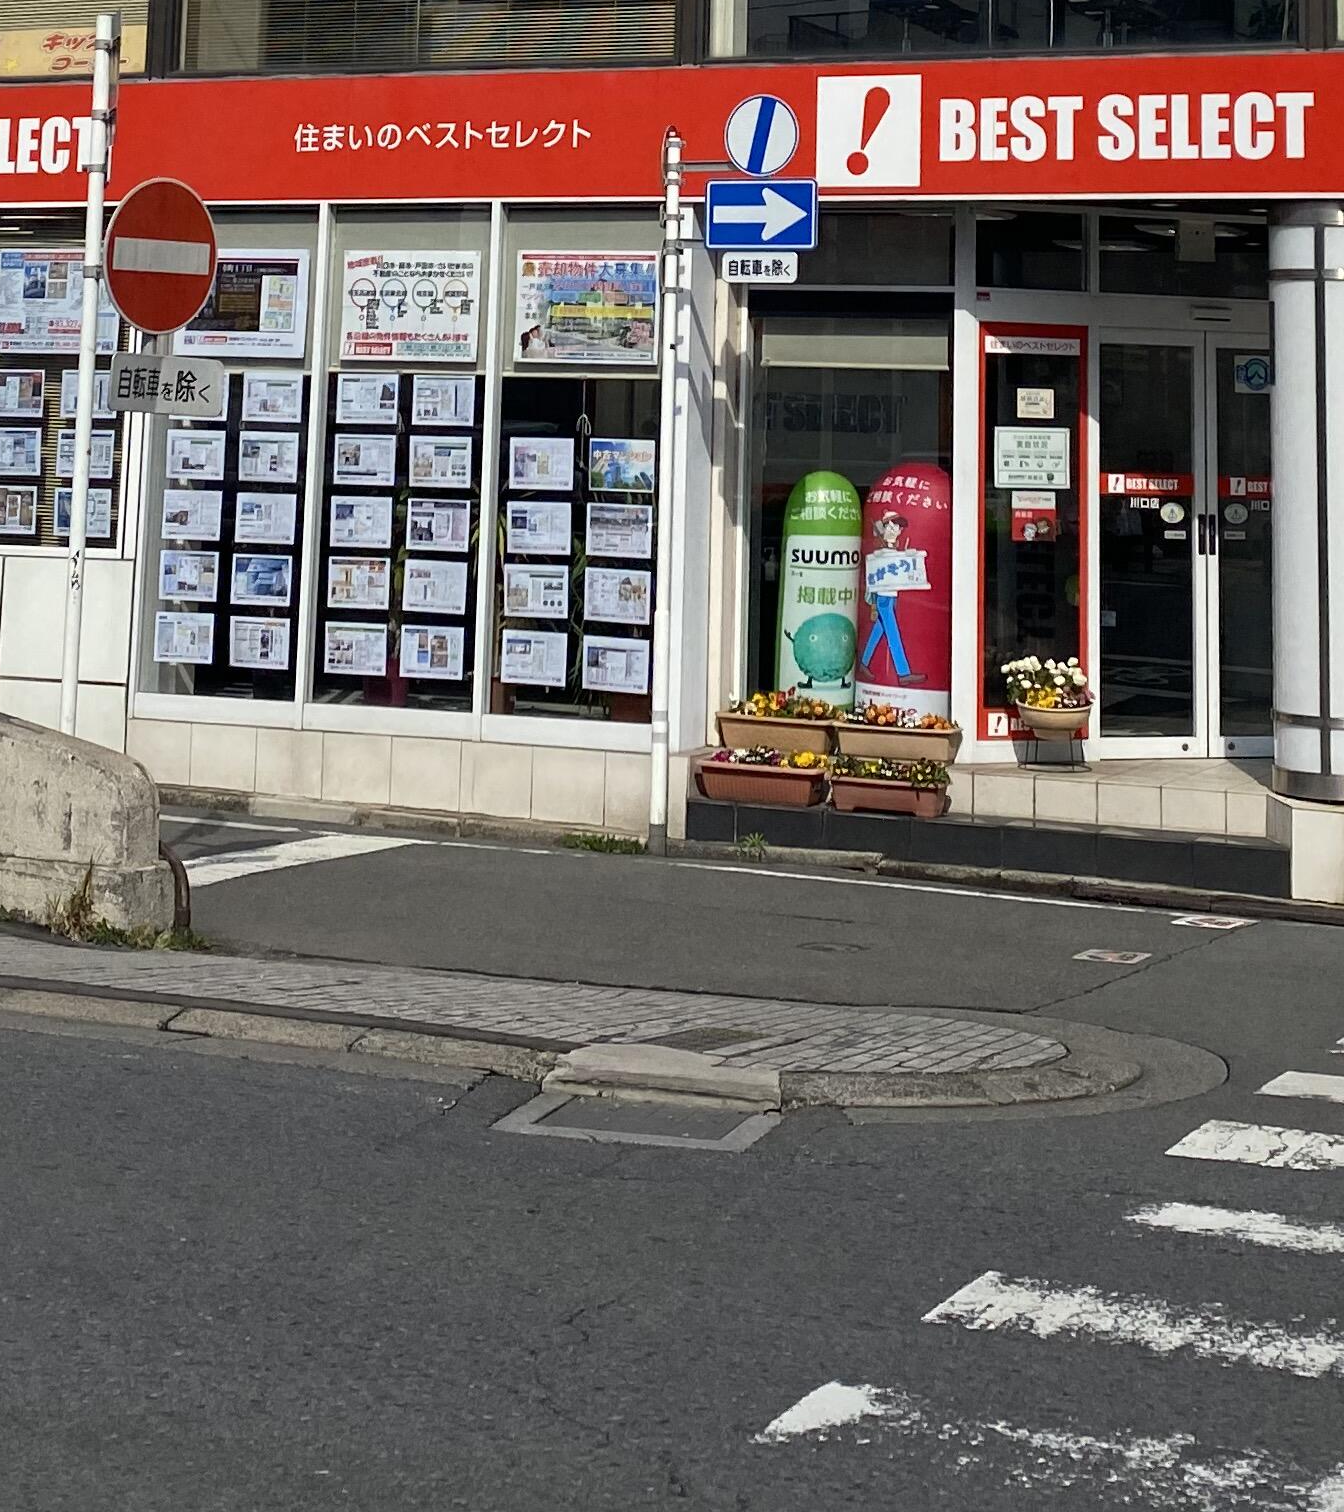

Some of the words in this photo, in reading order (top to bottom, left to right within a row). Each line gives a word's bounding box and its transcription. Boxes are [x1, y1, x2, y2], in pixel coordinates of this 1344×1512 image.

[293, 118, 593, 153] 住まいのベストセレクト
[938, 94, 1084, 163] BEST
[1097, 91, 1315, 162] SELECT
[728, 259, 791, 277] 自転車を除く
[118, 366, 211, 404] 自転車を除く
[882, 475, 931, 491] お気軽に
[805, 489, 853, 504] お気軽に
